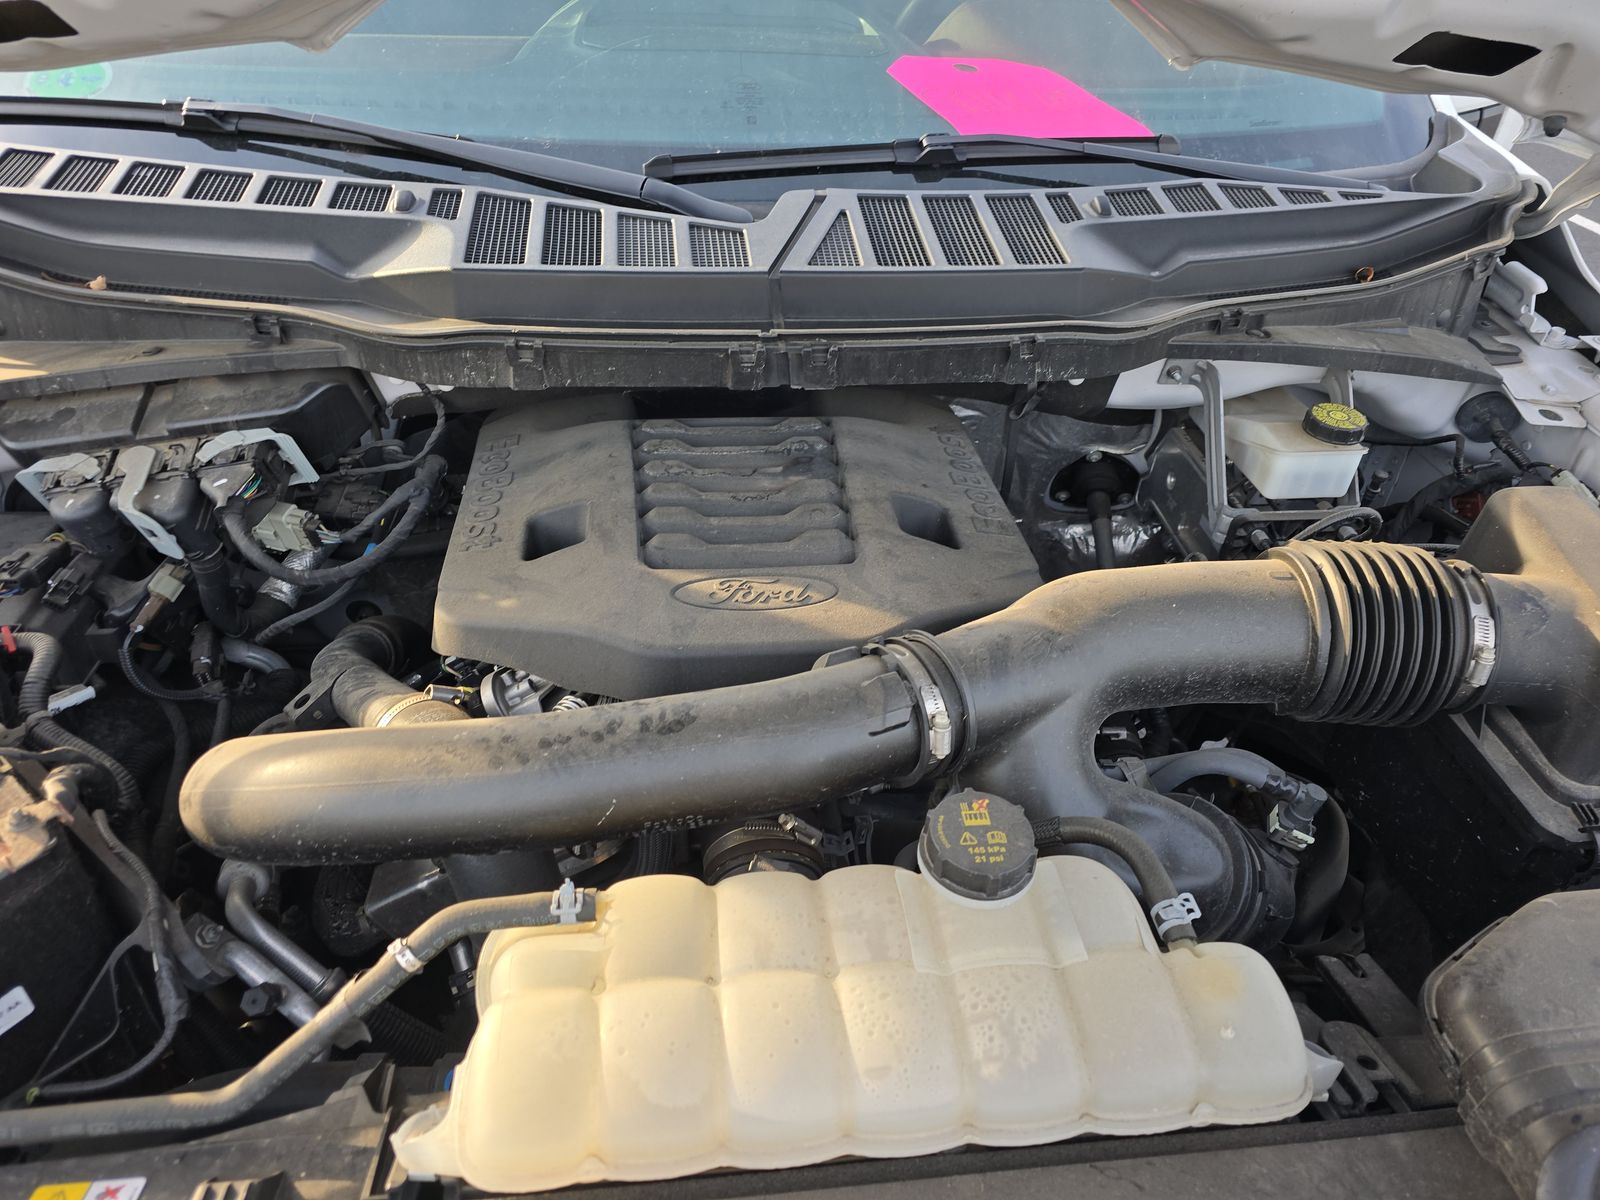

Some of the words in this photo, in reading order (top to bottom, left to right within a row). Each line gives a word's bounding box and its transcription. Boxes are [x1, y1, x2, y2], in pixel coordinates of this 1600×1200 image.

[708, 578, 809, 605] Ford
[967, 846, 986, 855] 145
[974, 855, 987, 863] 21
[989, 855, 1004, 863] psi
